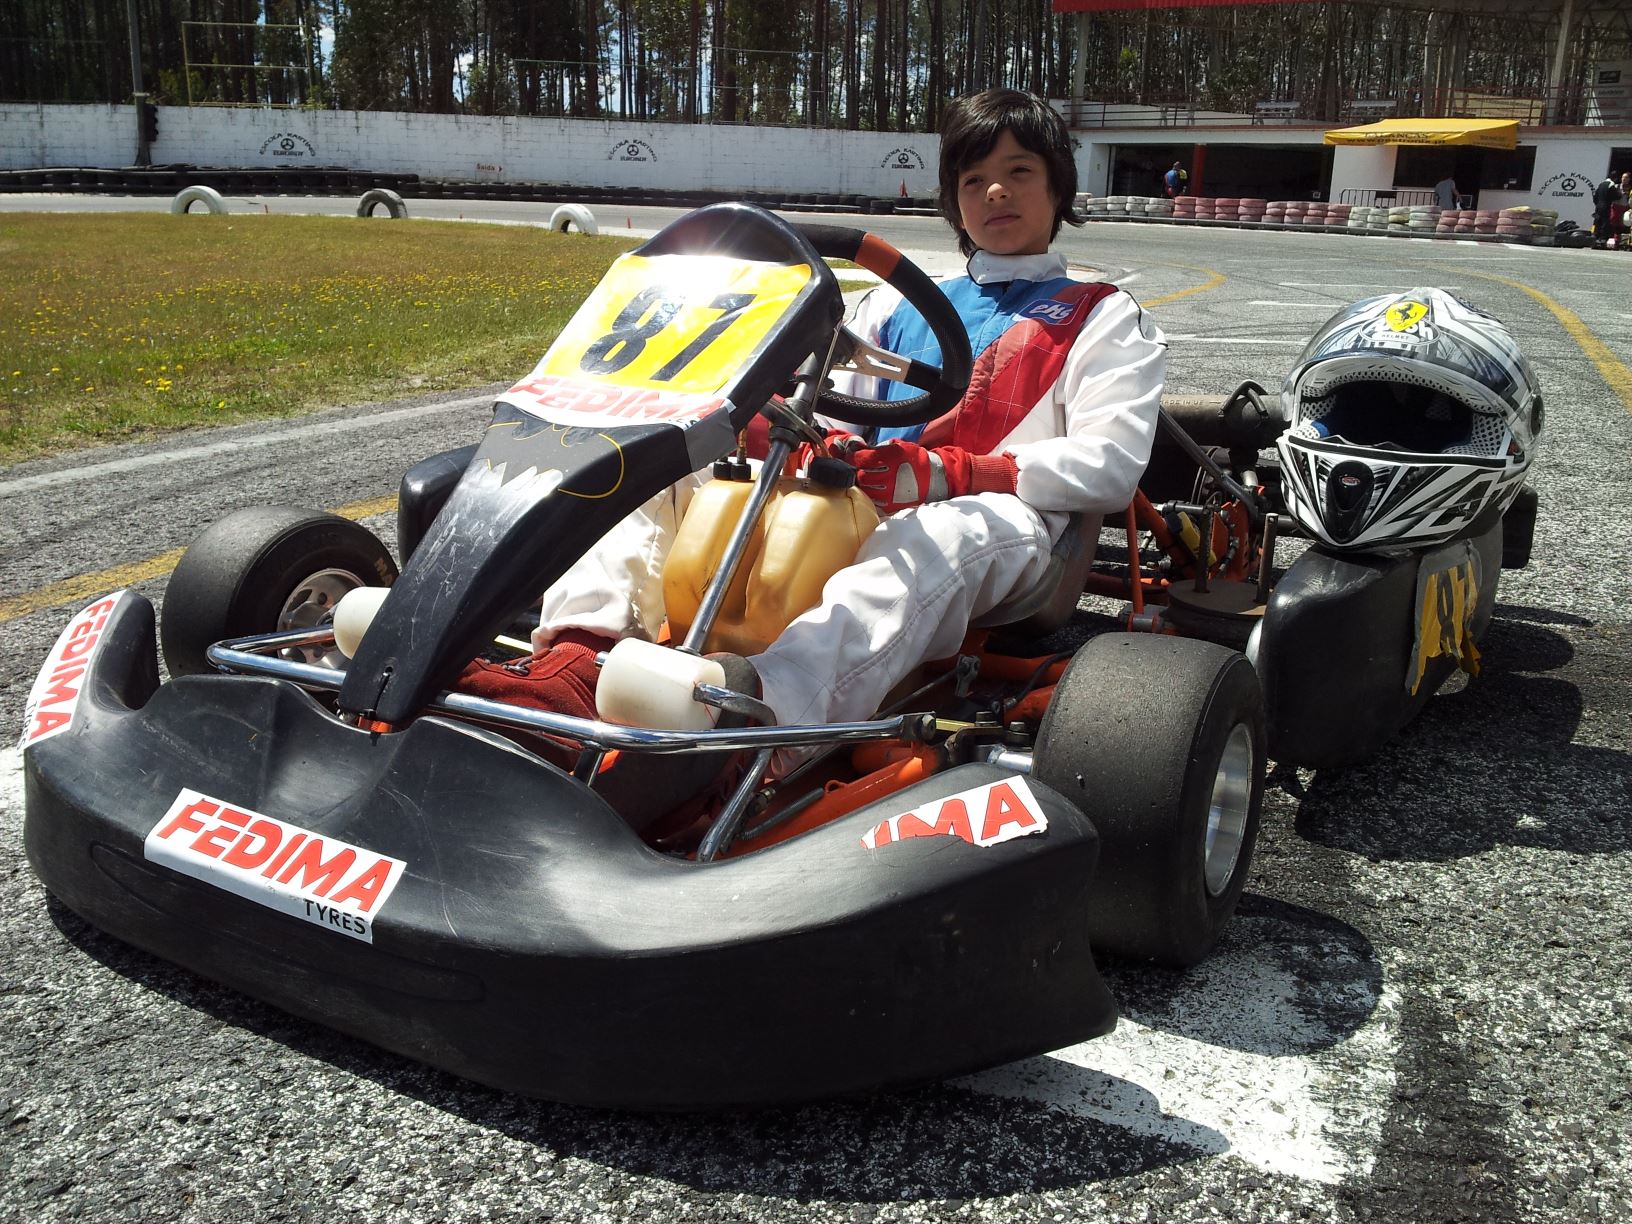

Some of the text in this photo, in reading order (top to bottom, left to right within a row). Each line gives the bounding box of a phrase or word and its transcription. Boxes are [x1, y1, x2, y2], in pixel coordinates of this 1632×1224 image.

[1538, 172, 1566, 196] ESCOLA
[579, 286, 758, 383] 87
[28, 599, 116, 741] FEDIMA
[156, 798, 393, 913] FEDIMA
[860, 782, 1038, 850] IMA
[303, 898, 367, 936] TYRES
